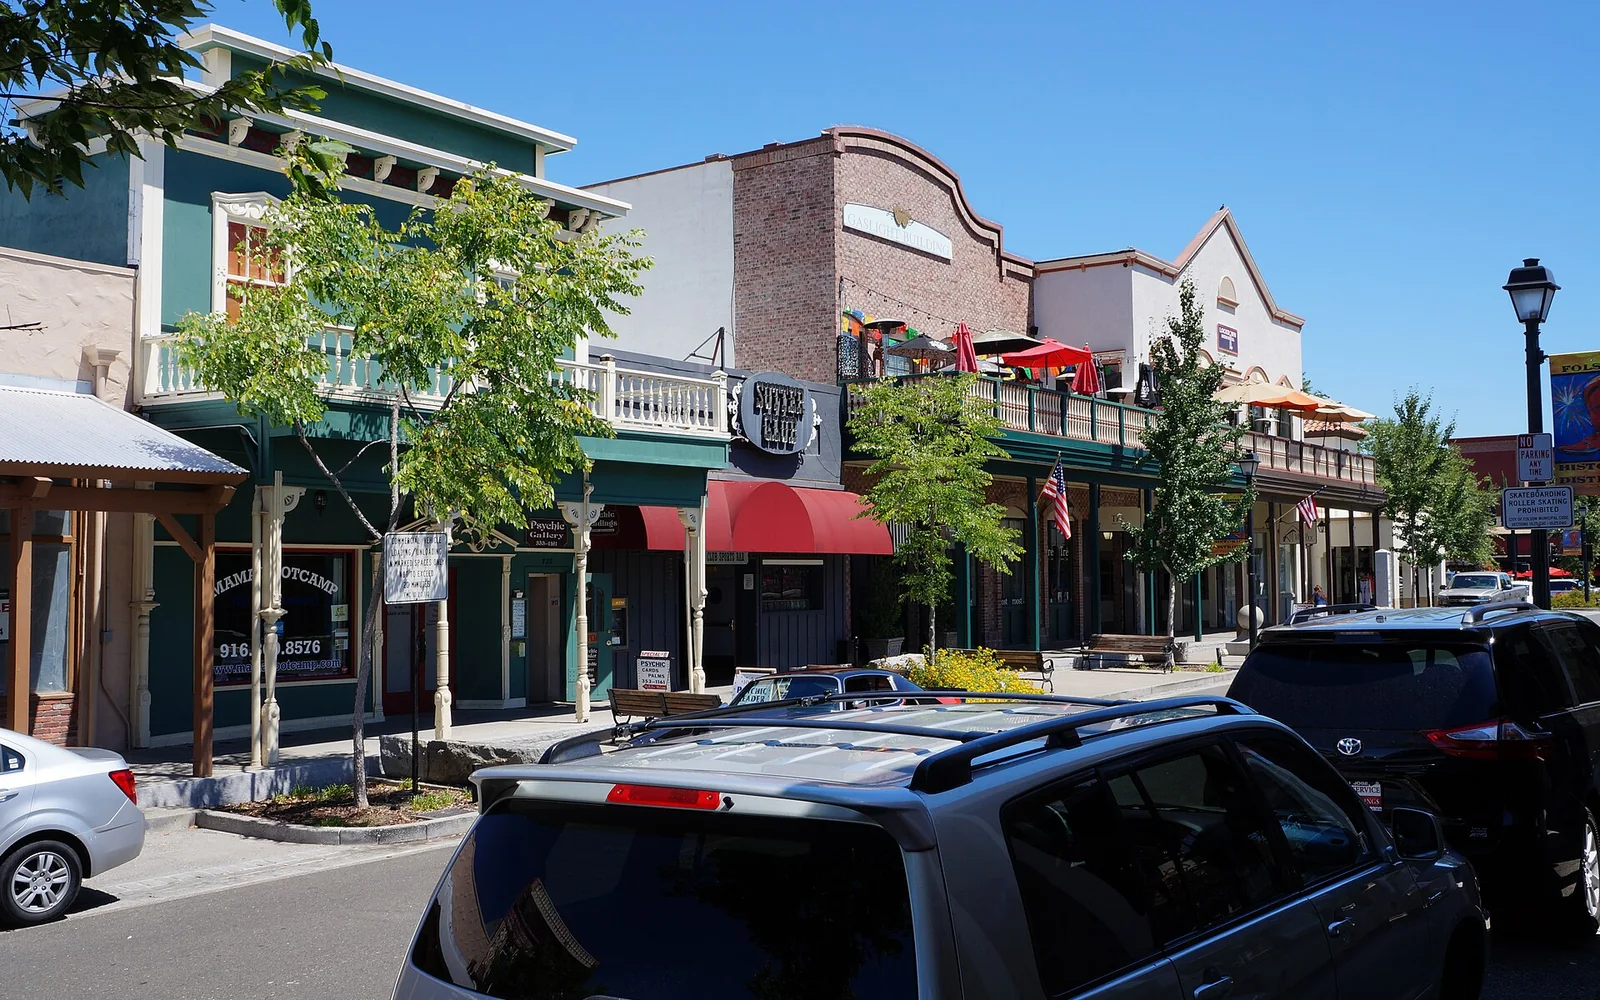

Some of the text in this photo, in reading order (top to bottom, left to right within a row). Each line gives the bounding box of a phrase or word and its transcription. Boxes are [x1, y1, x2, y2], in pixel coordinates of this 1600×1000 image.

[847, 213, 949, 255] GASLIGHT BUILDING
[1520, 436, 1532, 447] NO
[1521, 450, 1549, 459] PARKING
[1560, 476, 1600, 484] DIST
[1509, 491, 1567, 499] SKATEBOARDING
[530, 520, 565, 531] Psychic
[529, 531, 564, 540] Gallery
